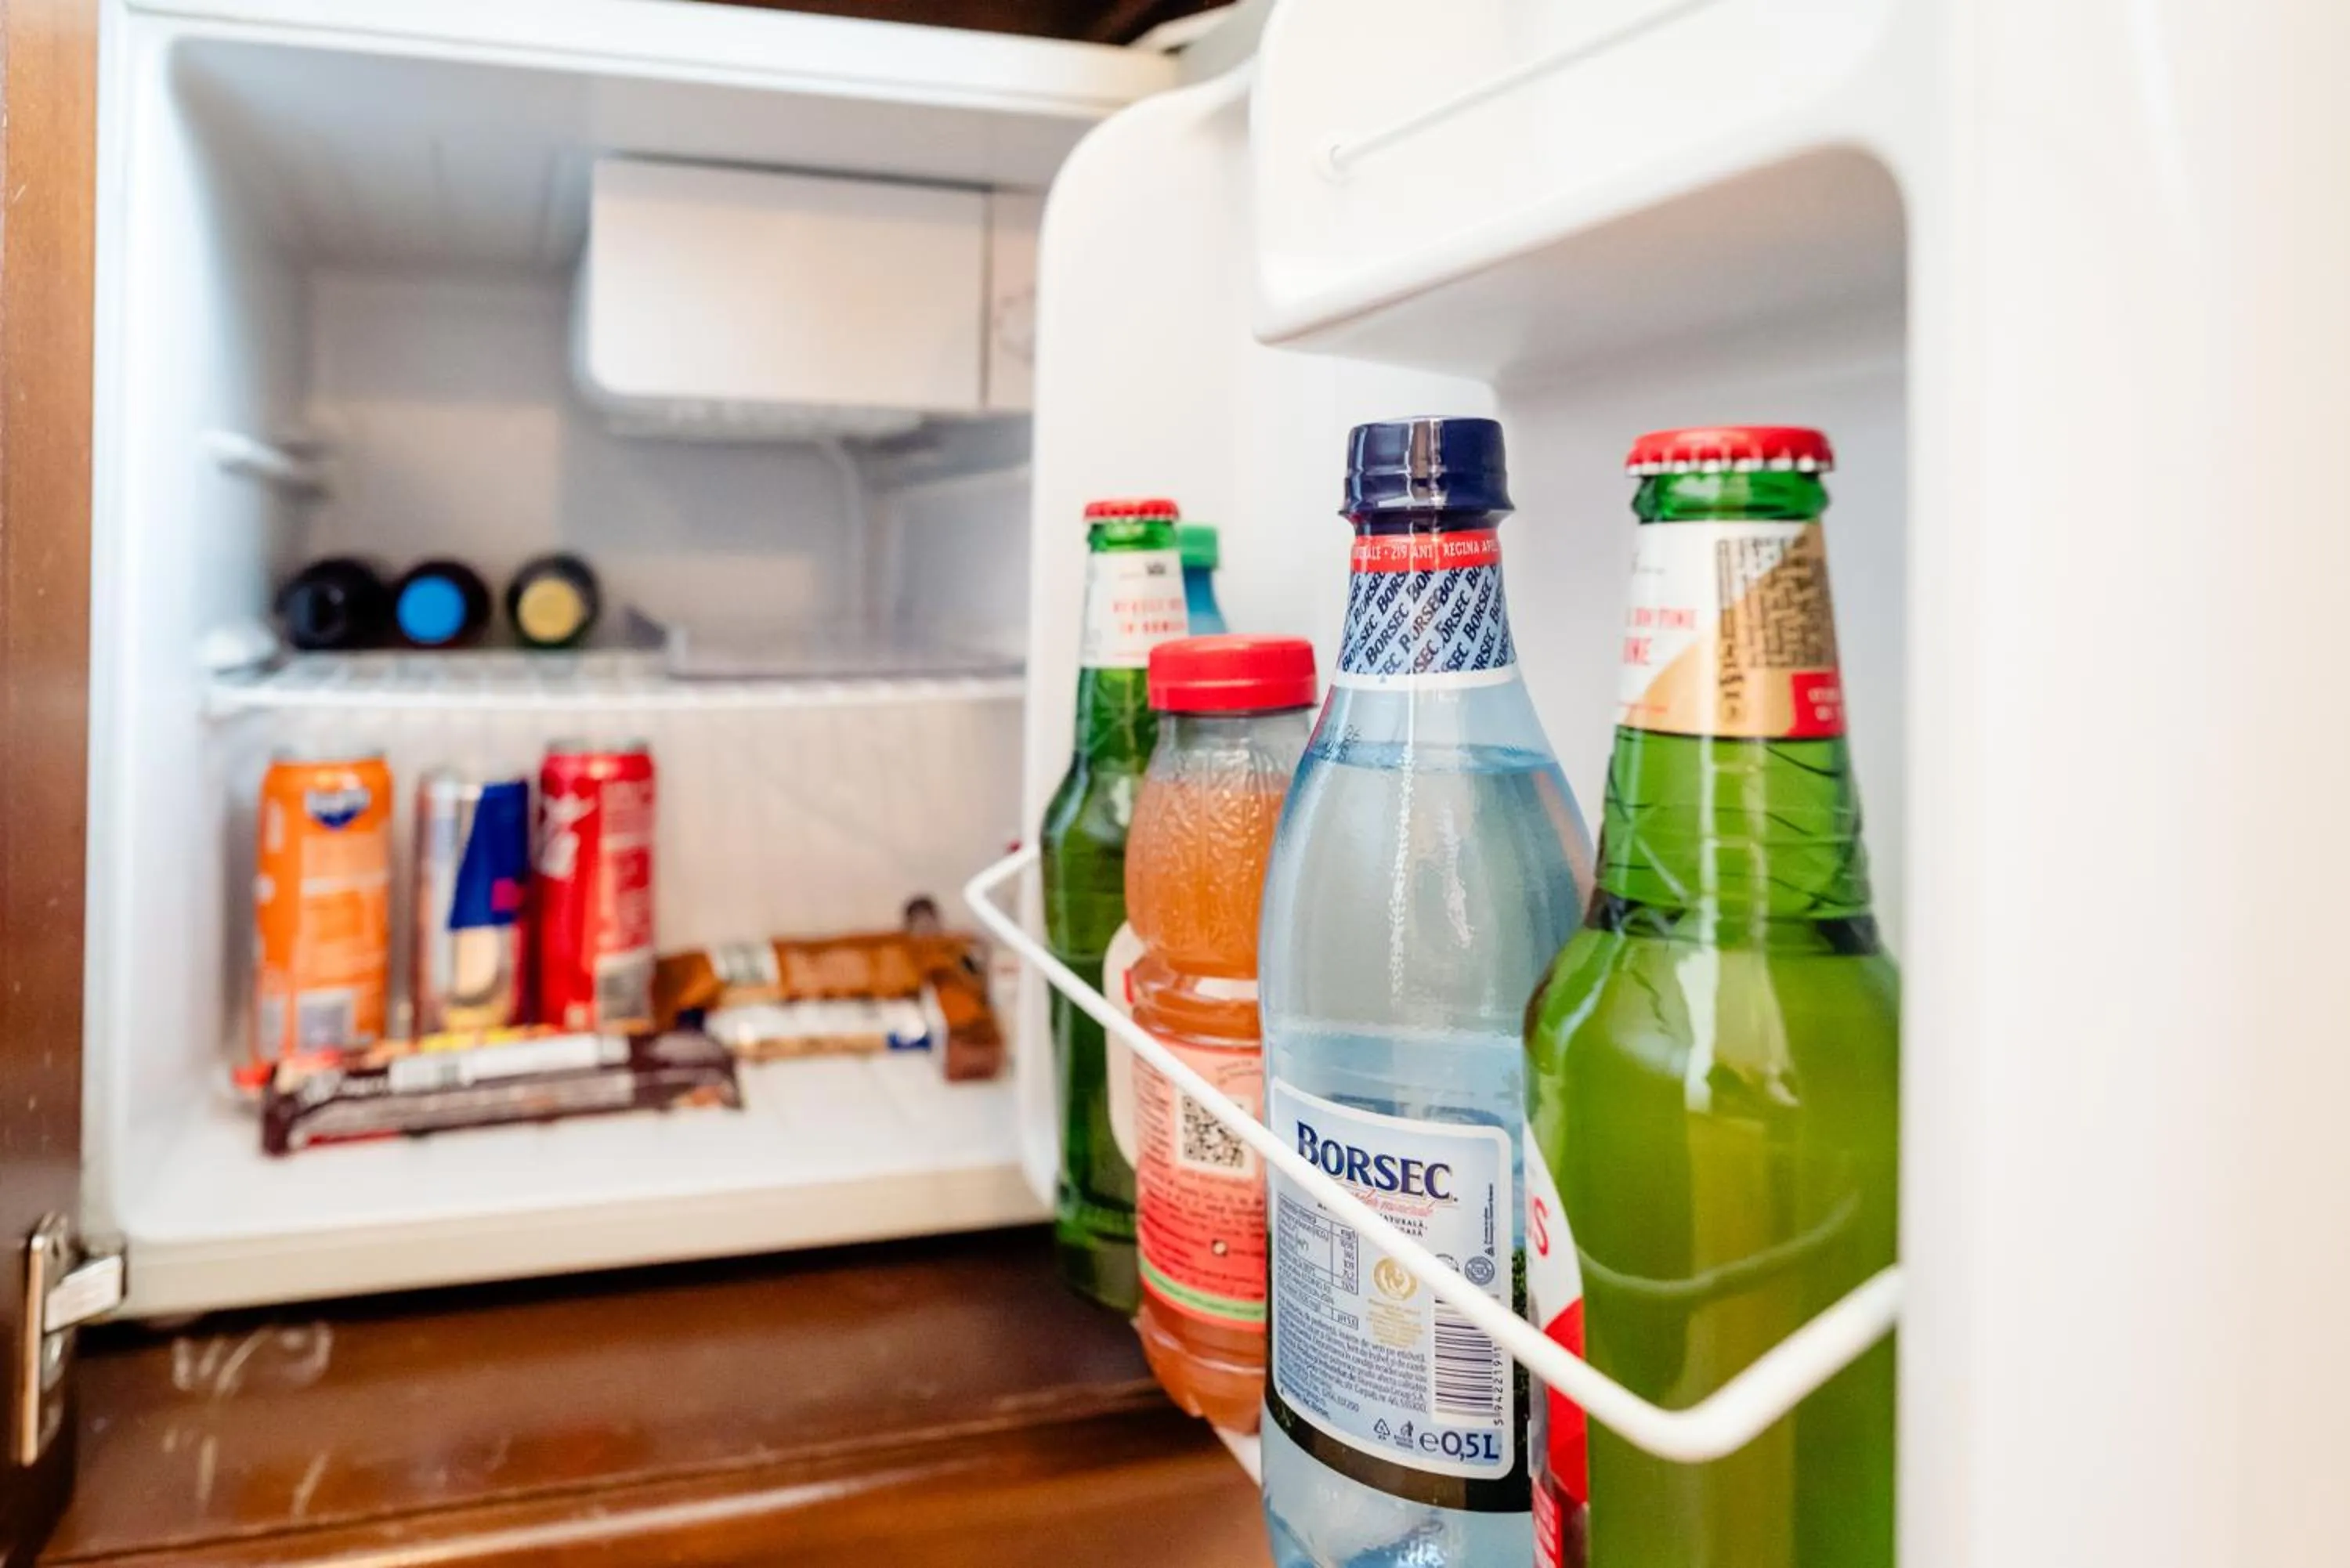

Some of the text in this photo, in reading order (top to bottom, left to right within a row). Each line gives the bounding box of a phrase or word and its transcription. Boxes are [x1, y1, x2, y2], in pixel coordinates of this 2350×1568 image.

[1410, 544, 1433, 561] ANI
[1444, 540, 1480, 557] REGINA
[1365, 602, 1409, 667] BORSEC
[1462, 576, 1493, 644] BORSEC
[1297, 1120, 1452, 1201] BORSEC
